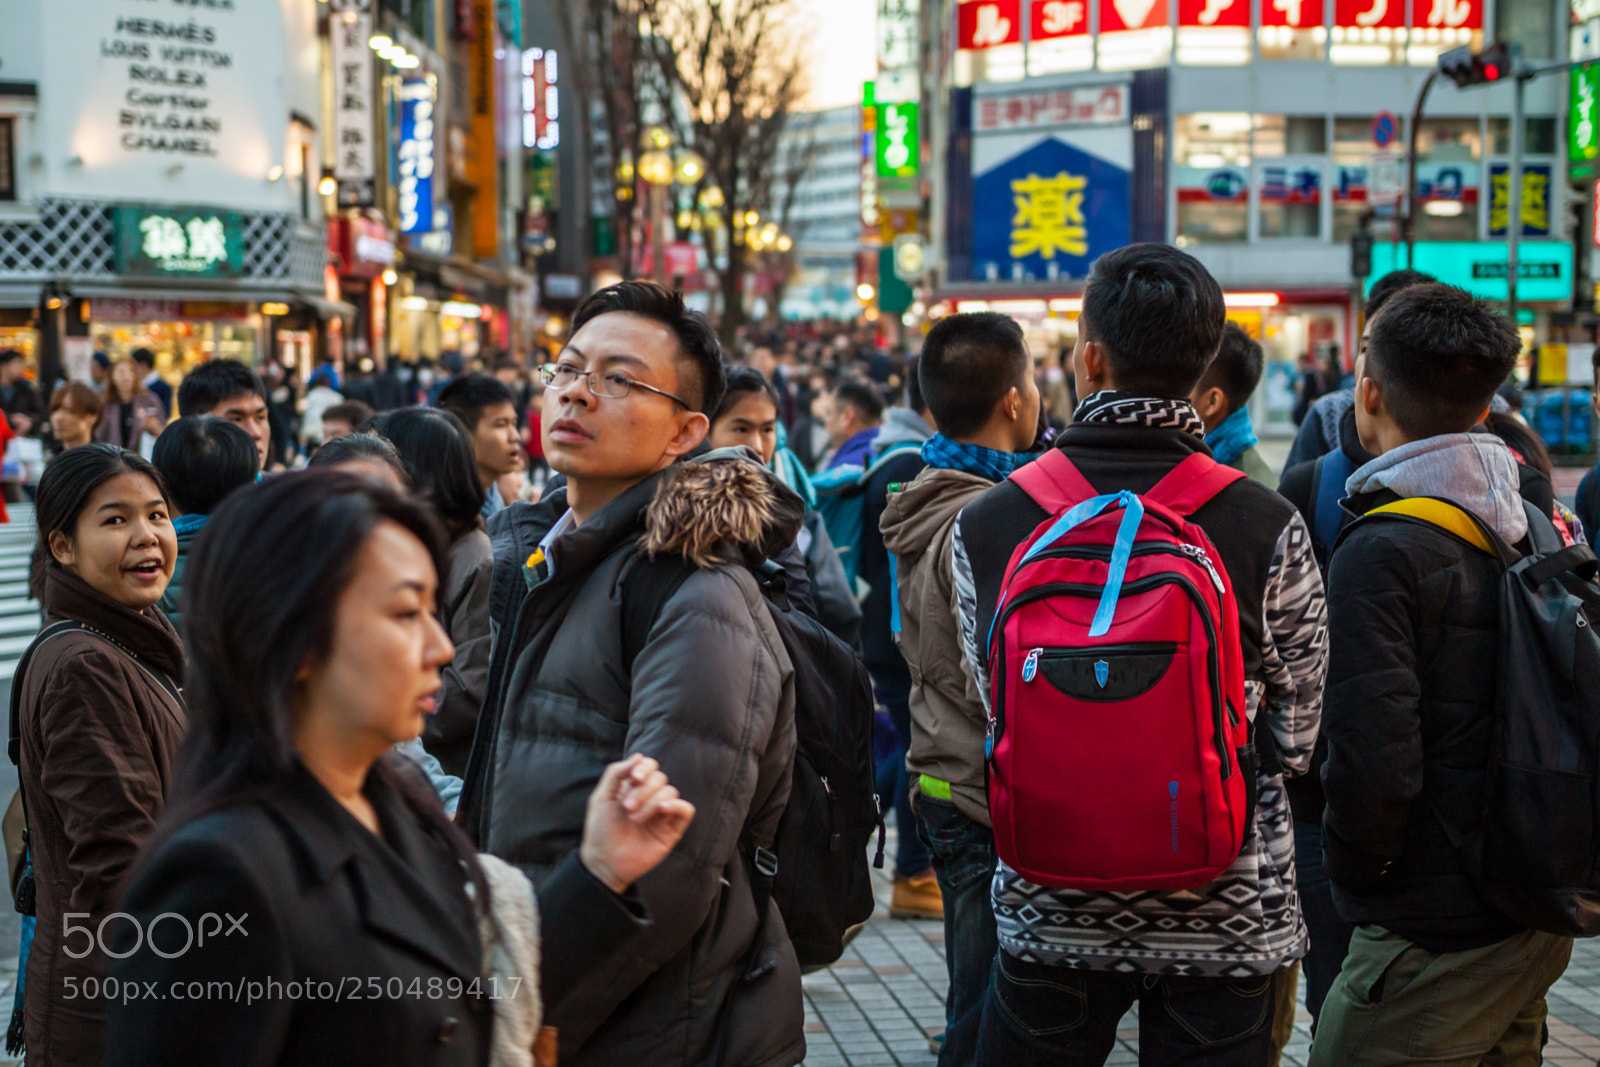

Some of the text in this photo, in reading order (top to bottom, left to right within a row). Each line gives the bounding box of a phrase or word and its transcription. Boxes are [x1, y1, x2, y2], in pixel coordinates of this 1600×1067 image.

[1042, 1, 1084, 34] 3F
[100, 38, 232, 68] LOUIS VUTTON
[129, 64, 206, 87] ROLEX
[119, 109, 221, 133] BVLGARI
[120, 132, 218, 156] CHANEL
[1009, 171, 1088, 259] 薬
